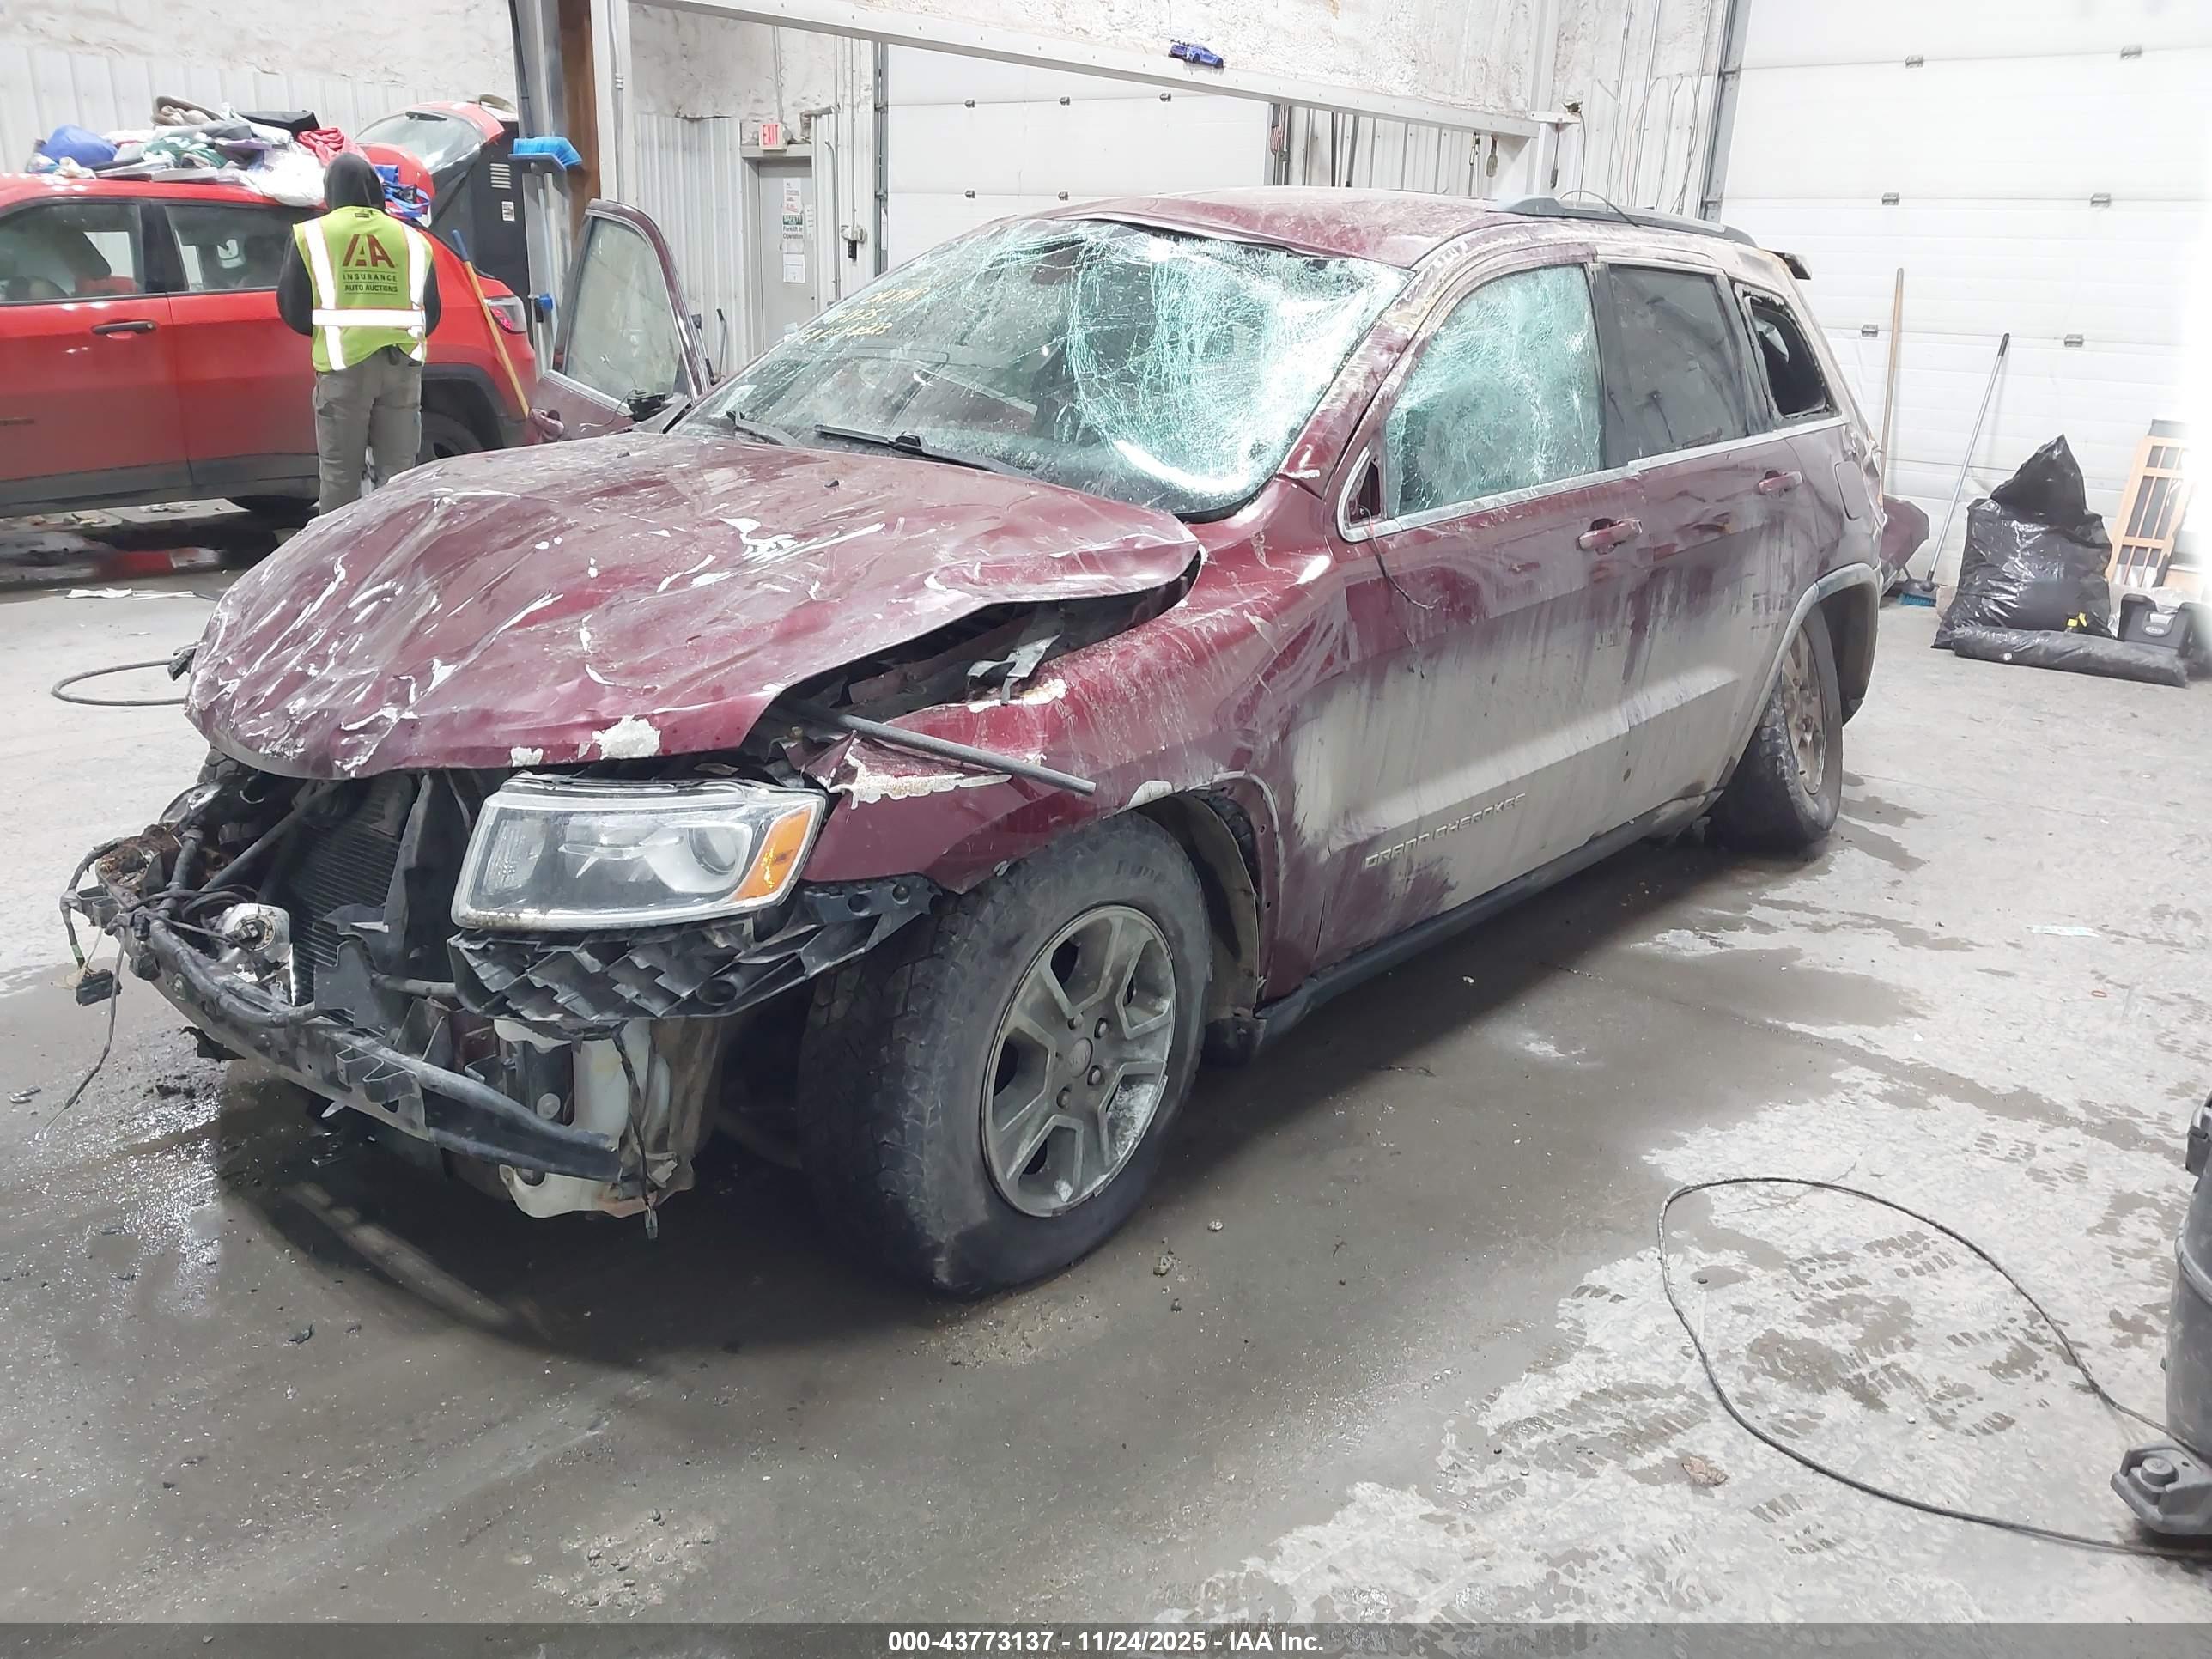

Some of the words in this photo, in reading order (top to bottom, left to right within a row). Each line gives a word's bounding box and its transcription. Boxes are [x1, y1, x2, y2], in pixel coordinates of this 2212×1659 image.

[763, 125, 778, 145] EXIT
[343, 273, 398, 282] INSURANCE
[365, 284, 398, 293] AUCTIONS
